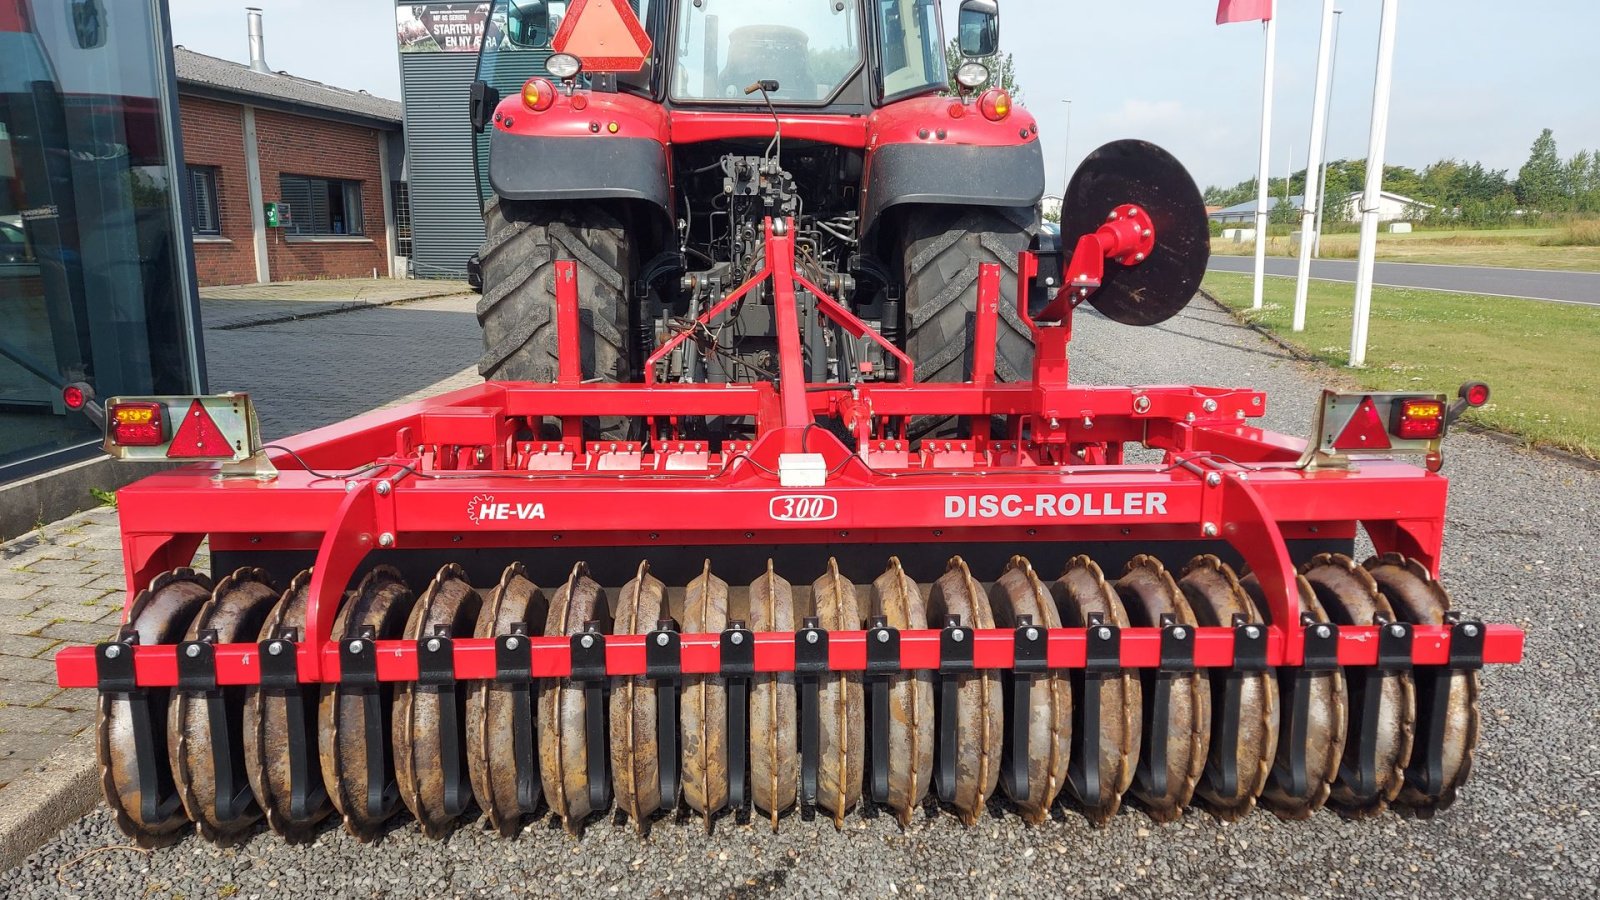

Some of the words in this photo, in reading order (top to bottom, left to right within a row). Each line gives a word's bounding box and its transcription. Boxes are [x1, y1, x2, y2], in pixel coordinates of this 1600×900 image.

[433, 23, 472, 35] STARTEN
[474, 20, 485, 34] PÅ
[445, 36, 457, 47] EN
[459, 35, 470, 47] NY
[479, 503, 545, 520] HE-VA
[780, 497, 824, 518] 300
[944, 492, 1168, 518] DISC-ROLLER
